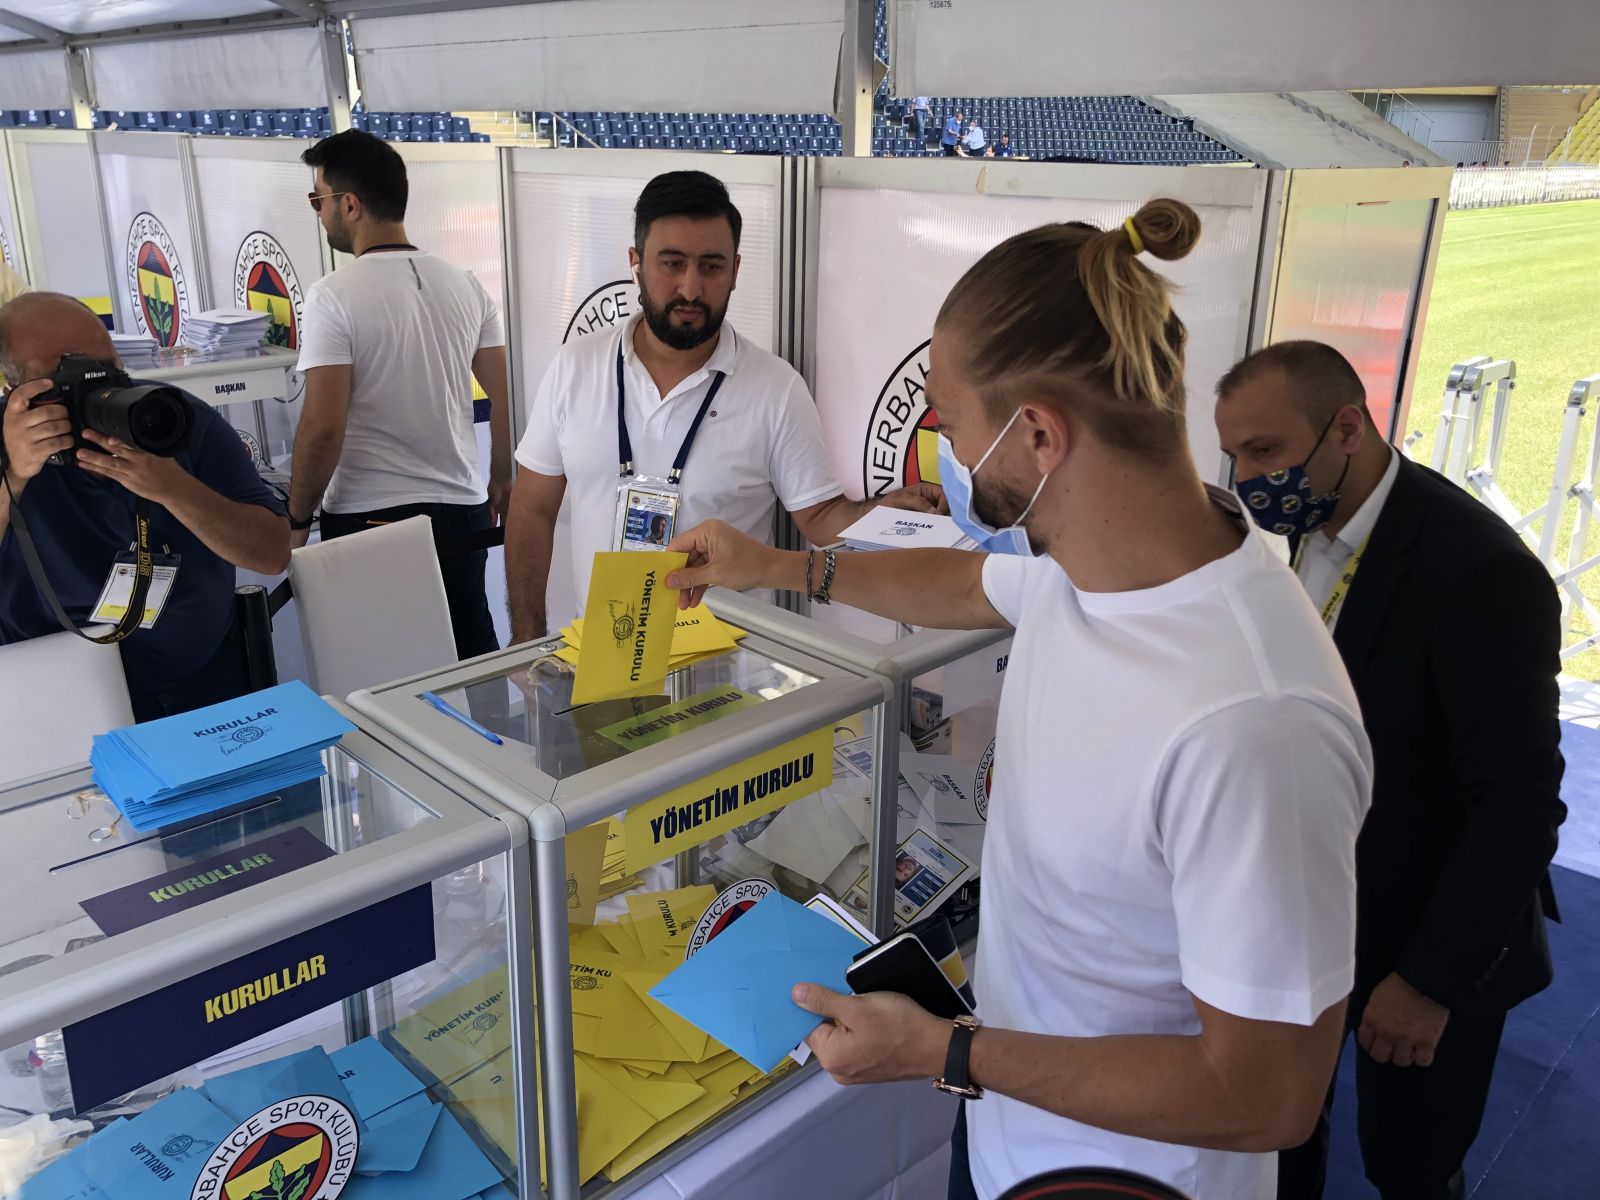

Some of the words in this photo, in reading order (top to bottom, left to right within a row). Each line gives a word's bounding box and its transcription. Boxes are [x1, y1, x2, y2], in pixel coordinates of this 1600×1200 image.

[148, 219, 174, 262] SPOR
[262, 239, 291, 283] SPOR
[84, 371, 106, 380] Nikon
[215, 382, 246, 395] BAŞKAN
[636, 570, 655, 629] YÖNETİM
[630, 630, 647, 682] KURULU
[193, 707, 279, 738] KURULLAR
[616, 710, 690, 741] YÖNETİM
[688, 691, 744, 717] KURULU
[650, 784, 739, 845] YÖNETİM
[743, 752, 814, 806] KURULU
[148, 852, 275, 903] KURULLAR
[735, 884, 768, 900] SPOR
[204, 954, 327, 1024] KURULLAR
[424, 1008, 475, 1042] YÖNETİM
[129, 1141, 176, 1182] KURULLAR
[269, 1100, 329, 1124] SPOR
[325, 1109, 357, 1186] KULÜBÜ
